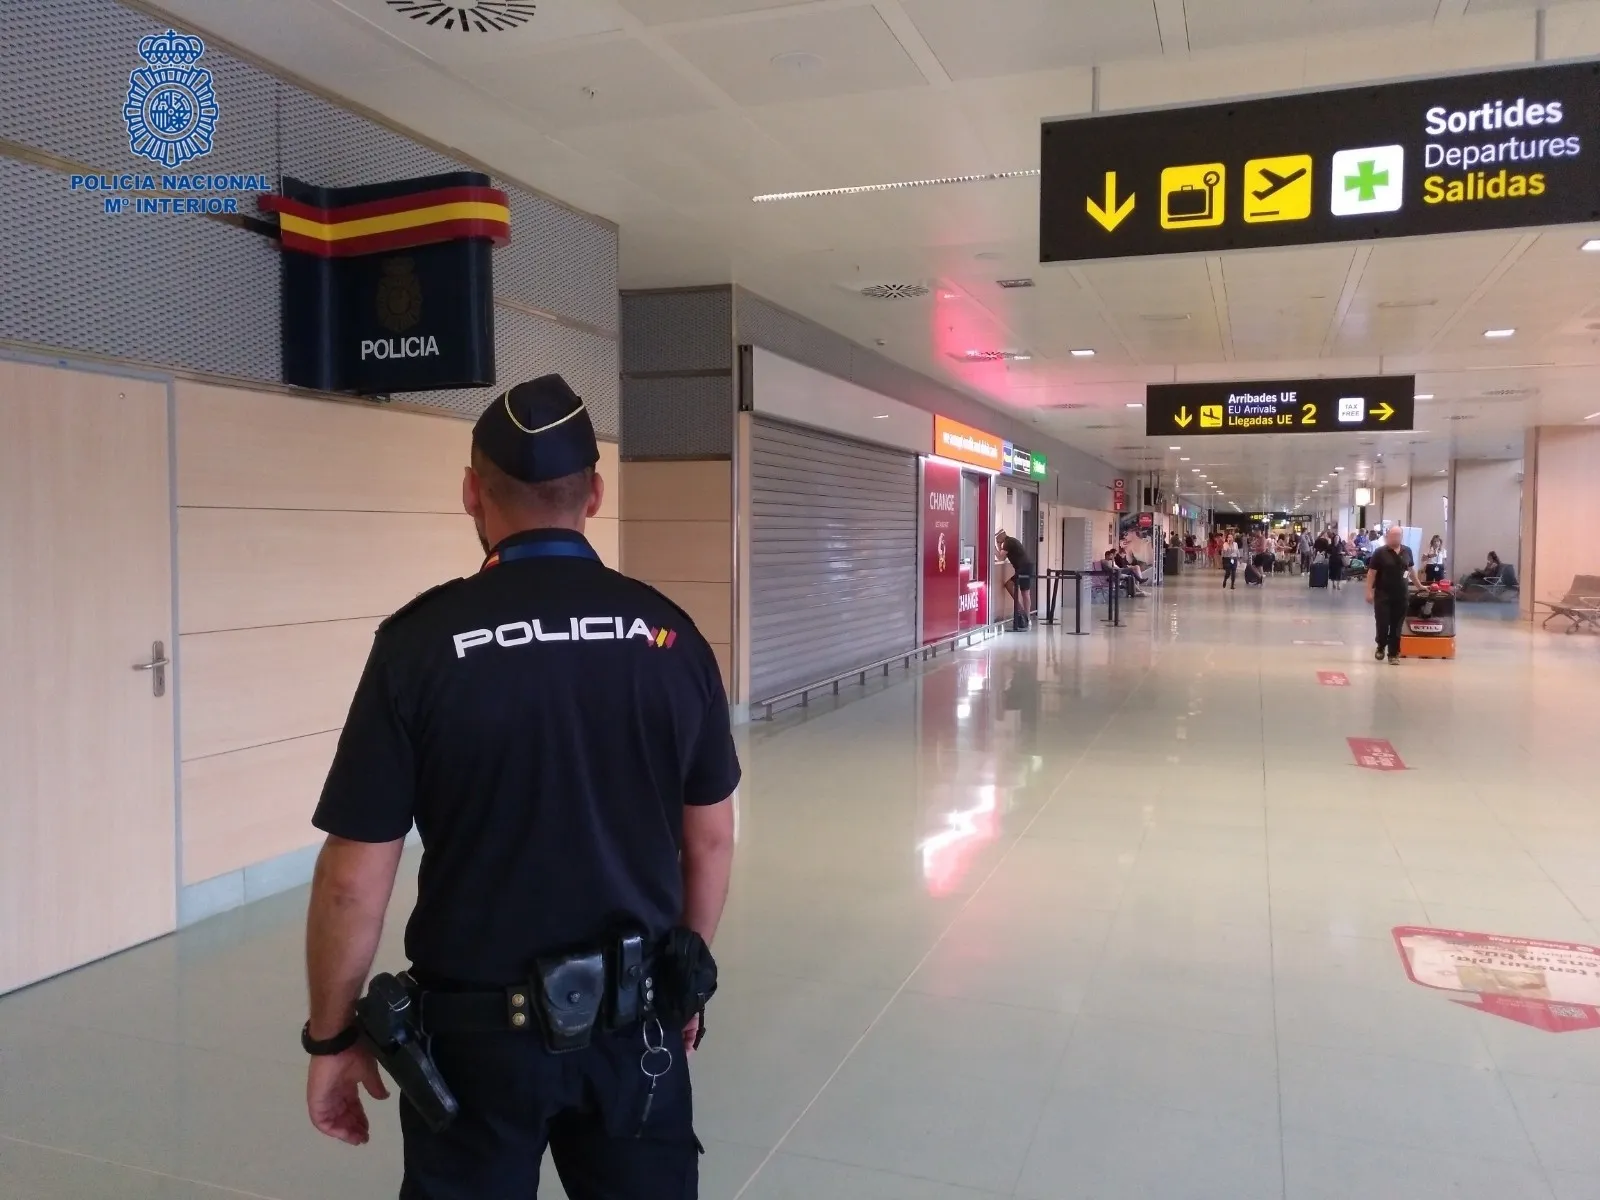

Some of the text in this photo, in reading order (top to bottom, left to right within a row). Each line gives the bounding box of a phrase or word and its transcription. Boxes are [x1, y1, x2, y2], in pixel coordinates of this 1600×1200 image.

[1425, 98, 1563, 135] Sortides
[1424, 136, 1581, 170] Departures
[1423, 169, 1546, 204] Salidas
[361, 335, 440, 360] POLICIA
[1228, 392, 1297, 404] Arribades UE
[1228, 404, 1277, 414] EU Arrivals
[1228, 415, 1293, 427] Llegadas UE
[1301, 403, 1317, 424] 2
[929, 492, 955, 511] CHANGE
[453, 616, 655, 659] POLICIA
